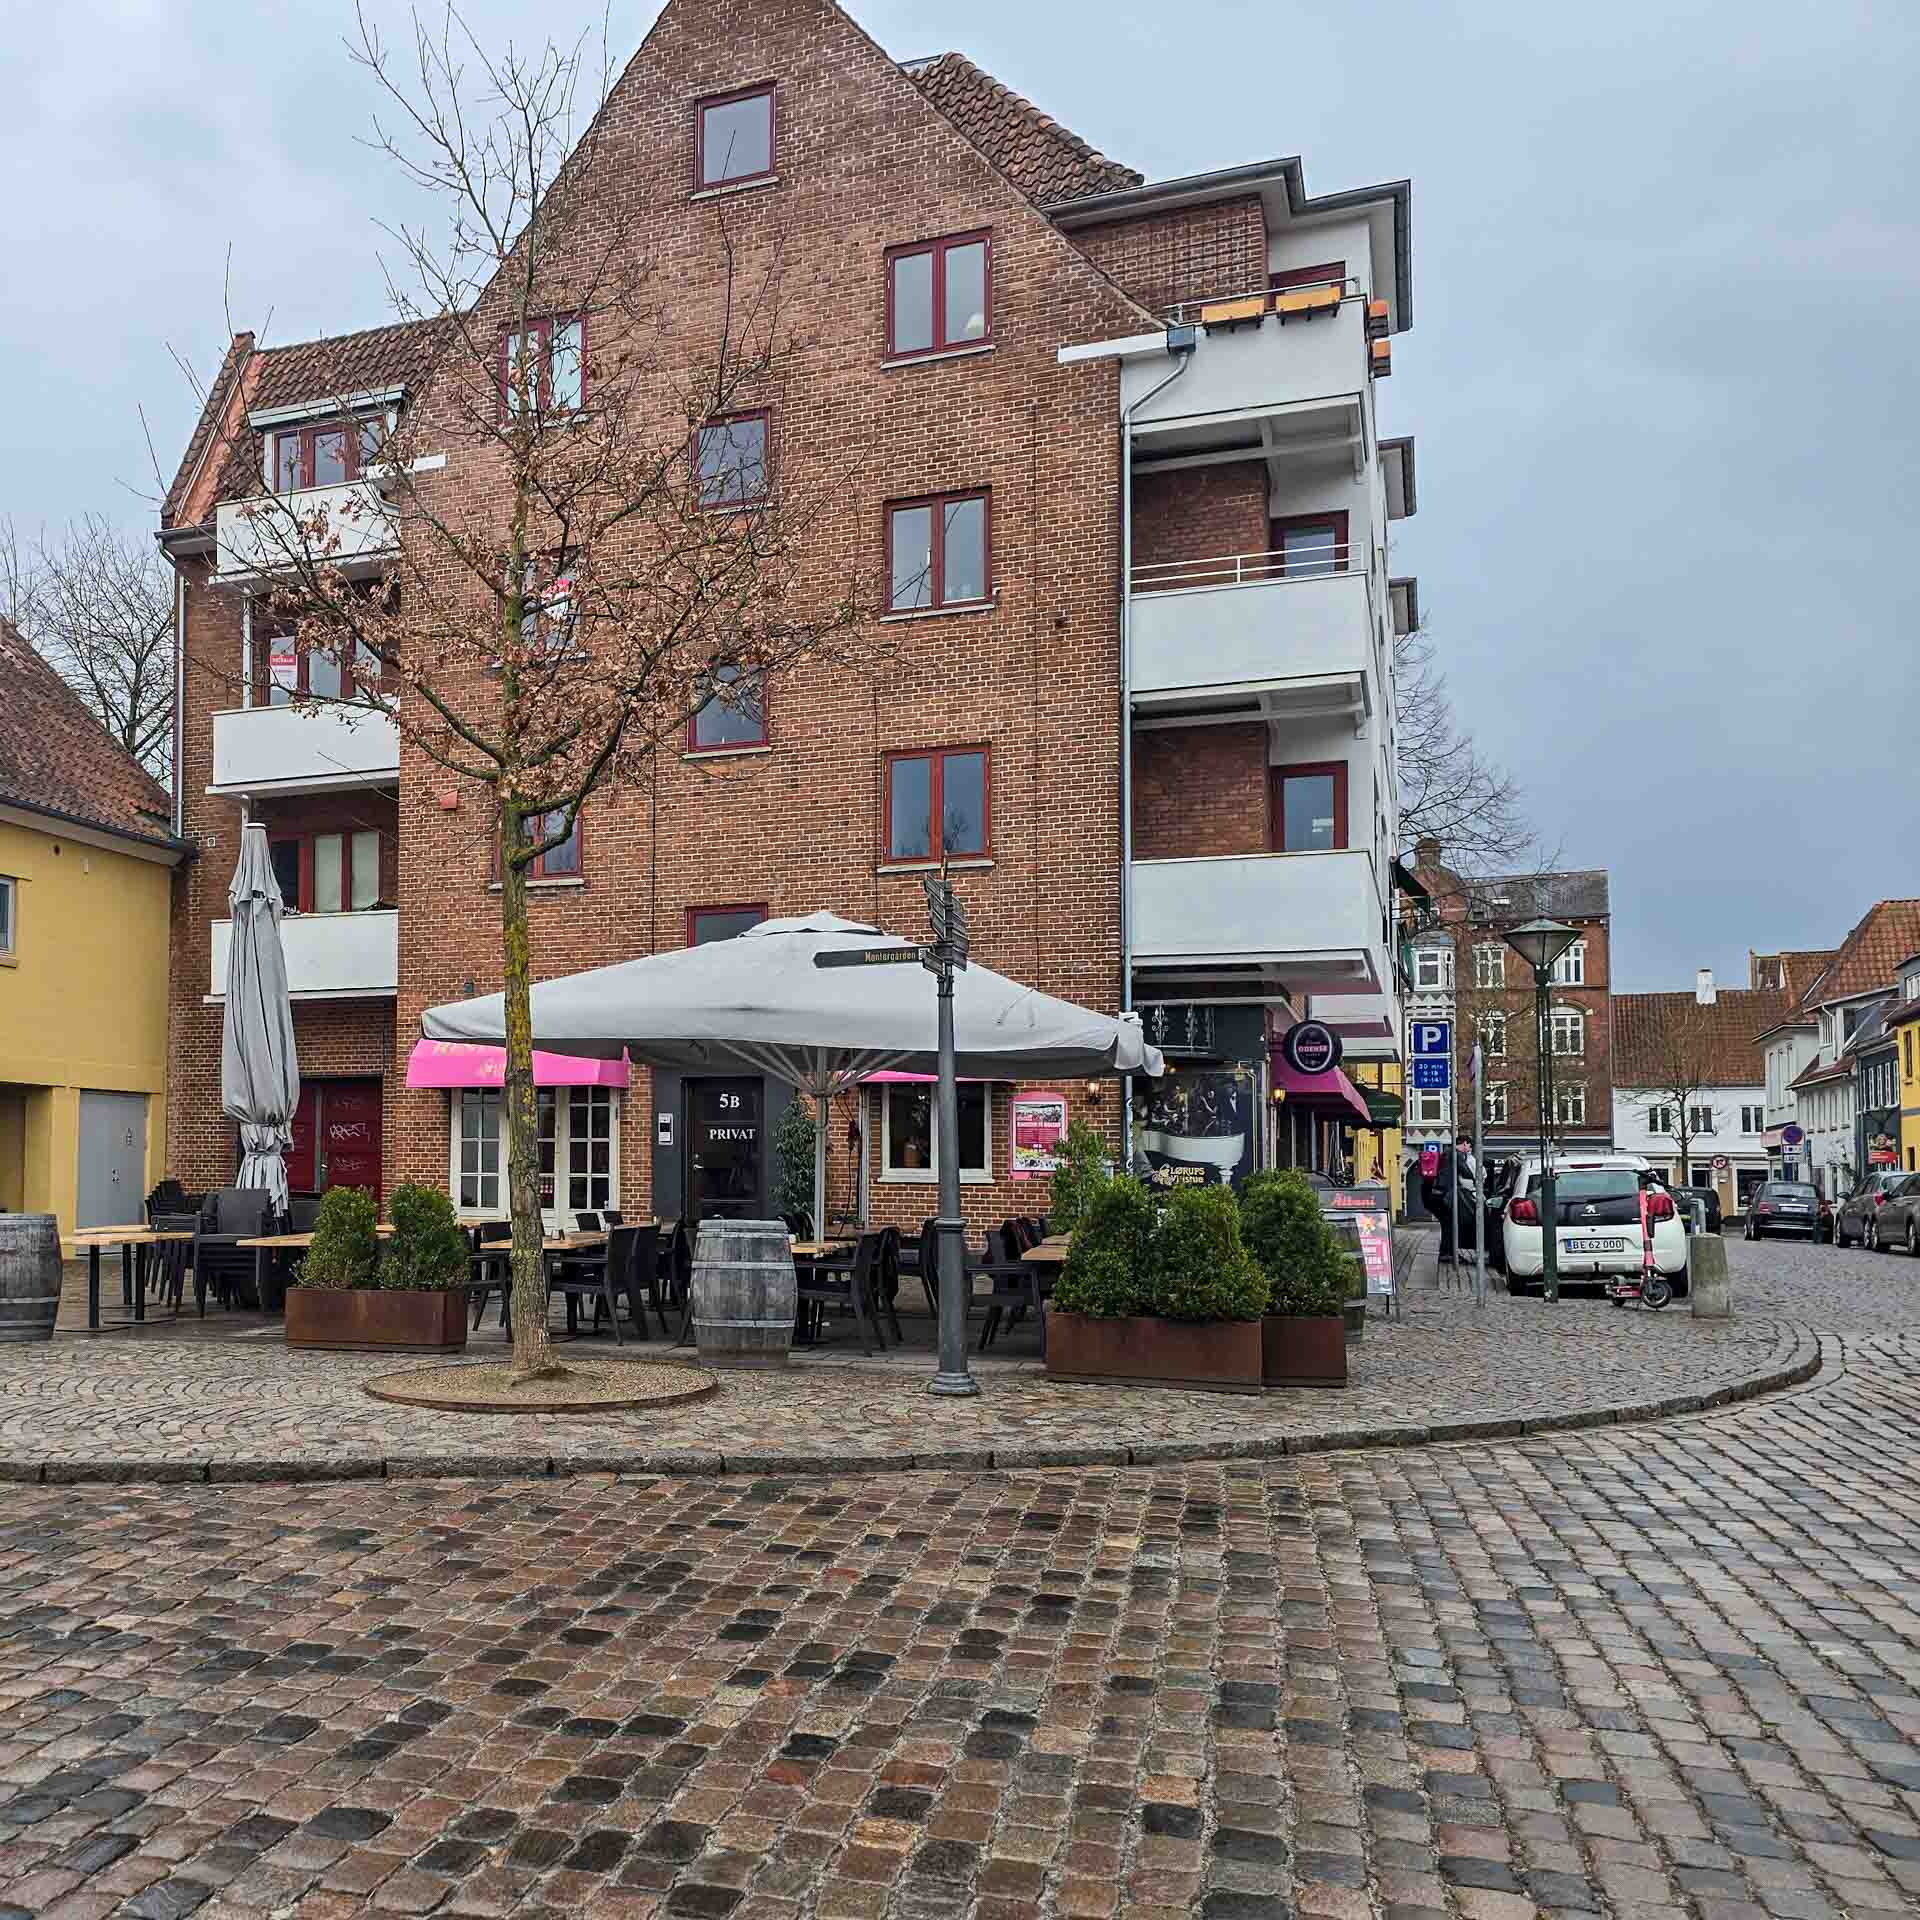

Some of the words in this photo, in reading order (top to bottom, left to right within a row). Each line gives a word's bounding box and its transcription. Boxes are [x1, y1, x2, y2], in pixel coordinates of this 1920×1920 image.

[1422, 1026, 1442, 1051] P
[719, 1093, 741, 1109] 5B
[709, 1128, 756, 1140] PRIVAT
[1170, 1167, 1205, 1176] LØRUPS
[1573, 1241, 1586, 1249] BE
[1588, 1240, 1600, 1249] 62
[1603, 1240, 1622, 1249] 000
